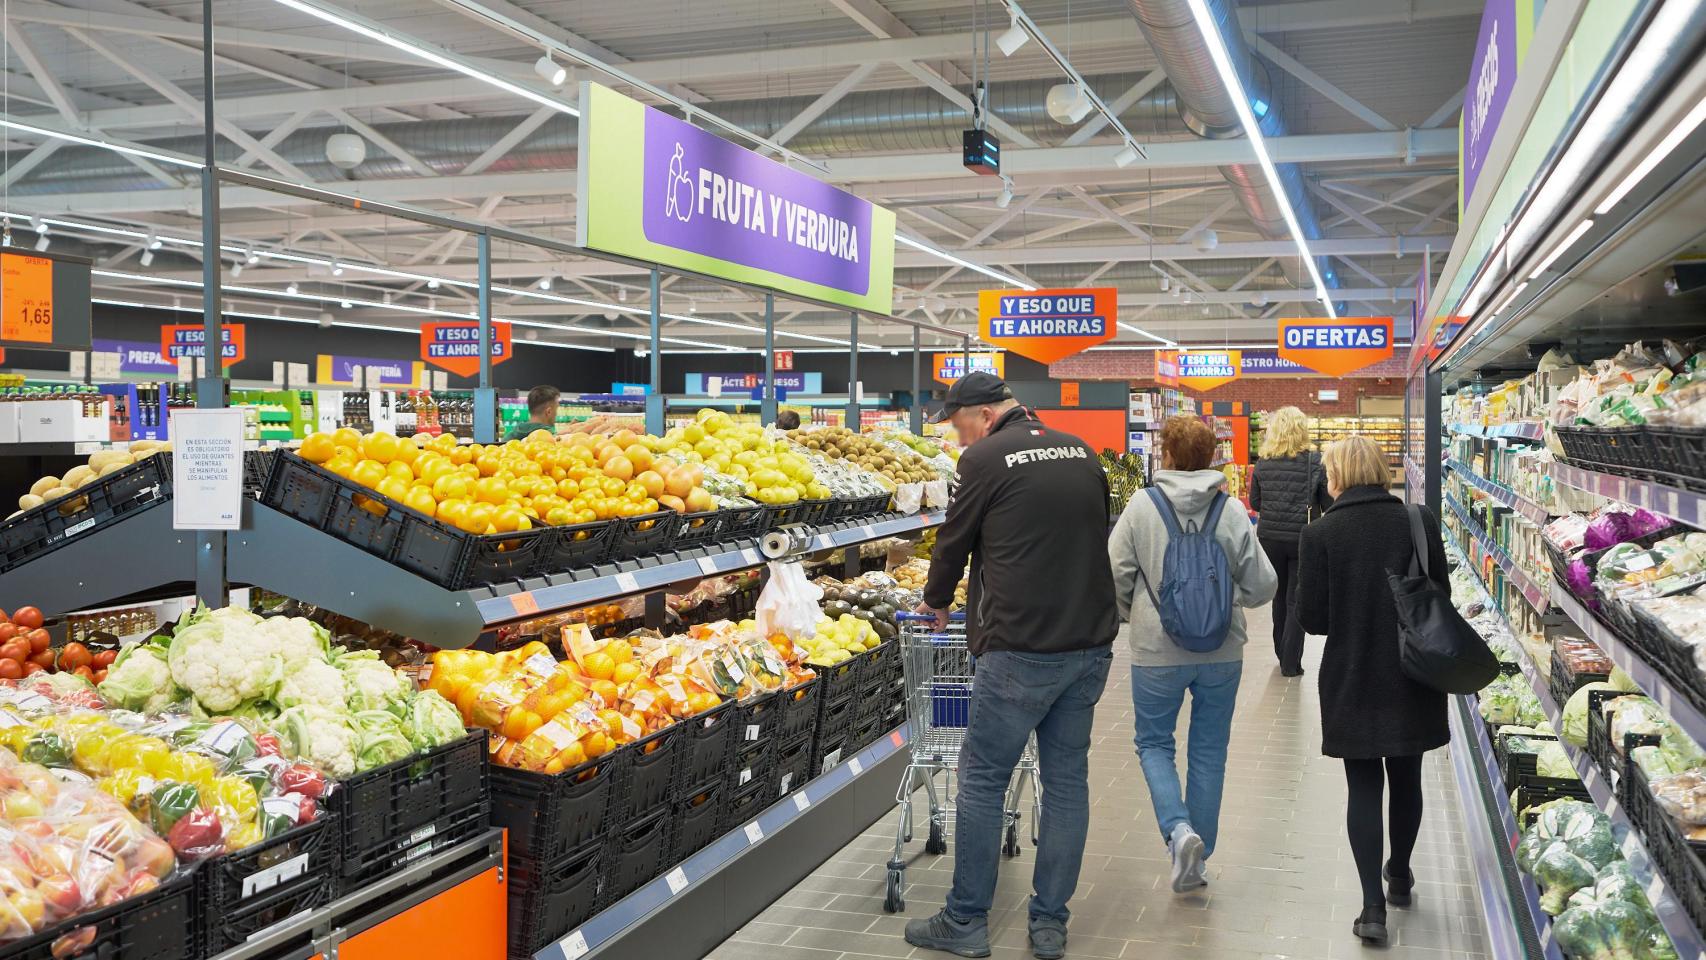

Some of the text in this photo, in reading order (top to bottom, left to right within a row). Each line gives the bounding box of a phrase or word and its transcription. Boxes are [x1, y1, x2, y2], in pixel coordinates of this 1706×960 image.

[697, 167, 859, 264] FRUTA Y VERDURA
[1003, 297, 1092, 314] Y ESO QUE
[21, 306, 51, 327] 1,65
[992, 318, 1103, 335] TE AHORRAS
[176, 330, 185, 342] Y
[437, 328, 445, 340] Y
[447, 328, 469, 340] ESO
[1286, 328, 1386, 346] OFERTAS
[169, 345, 184, 356] TE
[429, 343, 445, 356] TE
[128, 350, 172, 365] PREPA
[1178, 355, 1228, 365] Y ESO QUE
[1241, 358, 1273, 368] ESTRO
[940, 368, 953, 378] TE
[1186, 366, 1234, 376] AHORRAS
[1004, 446, 1088, 468] PETRONAS
